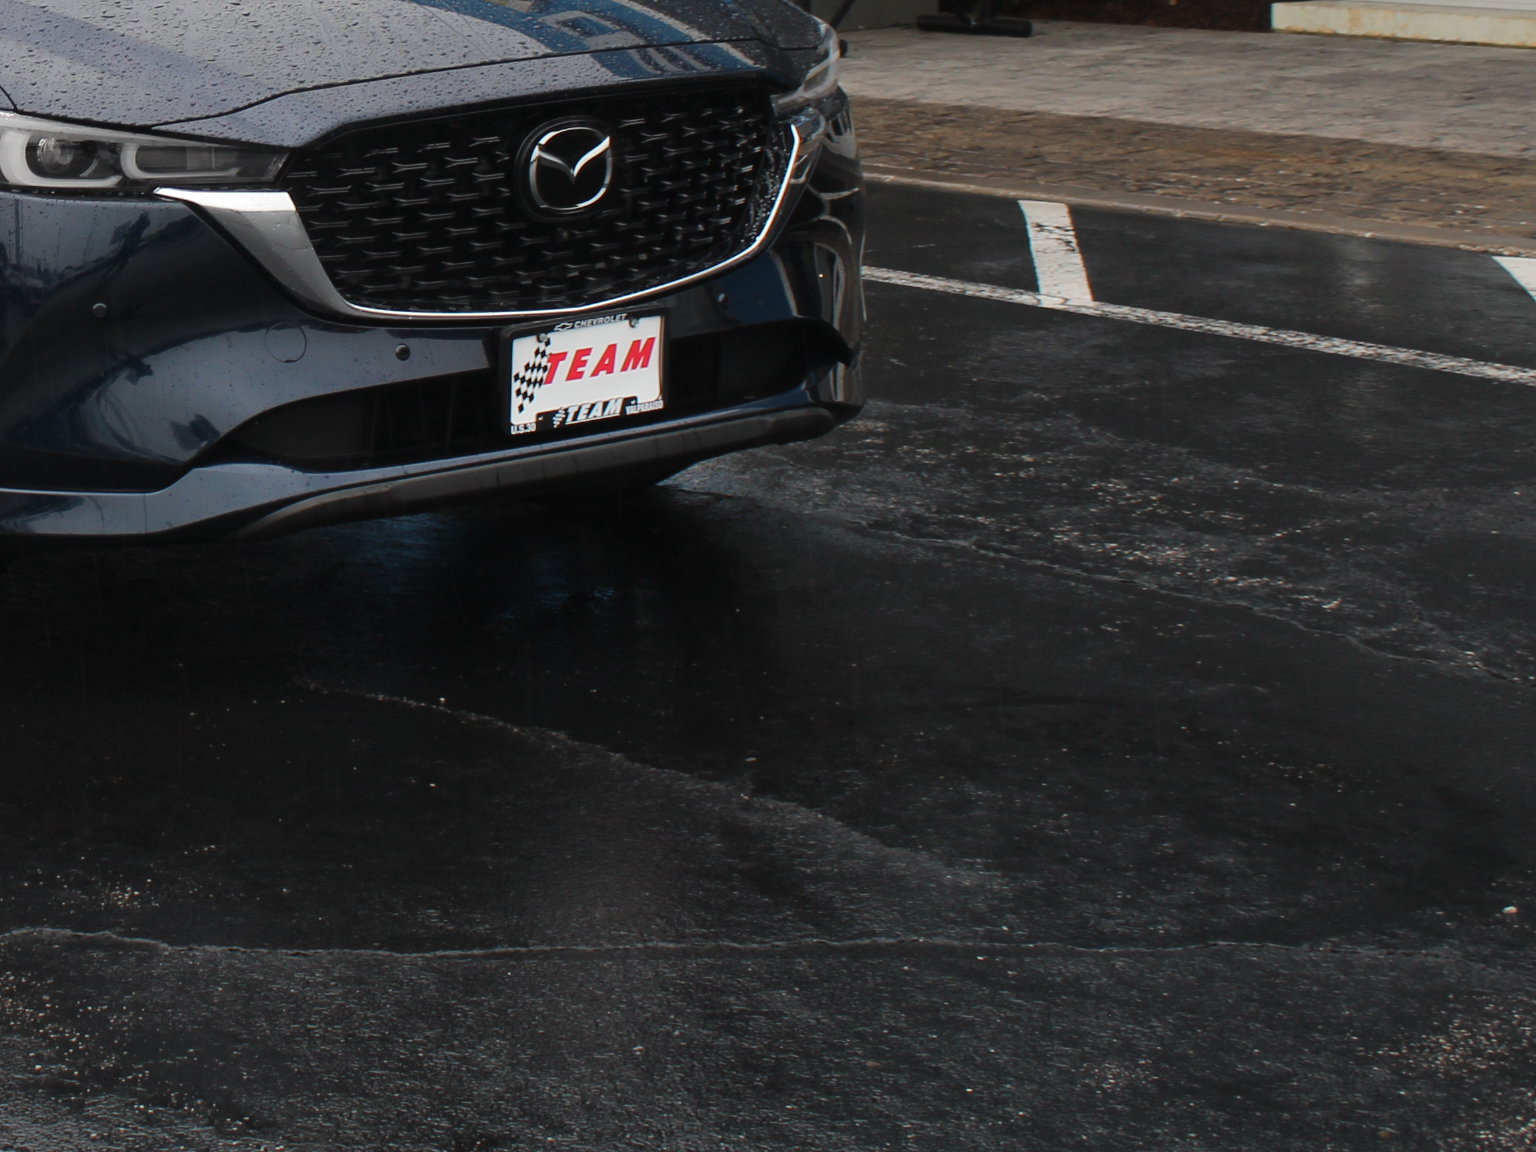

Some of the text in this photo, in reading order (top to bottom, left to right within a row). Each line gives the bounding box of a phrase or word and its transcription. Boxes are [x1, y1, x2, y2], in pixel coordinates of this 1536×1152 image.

[574, 313, 628, 328] CHEVROLET
[543, 336, 656, 385] TEAM
[565, 397, 624, 424] TEAM
